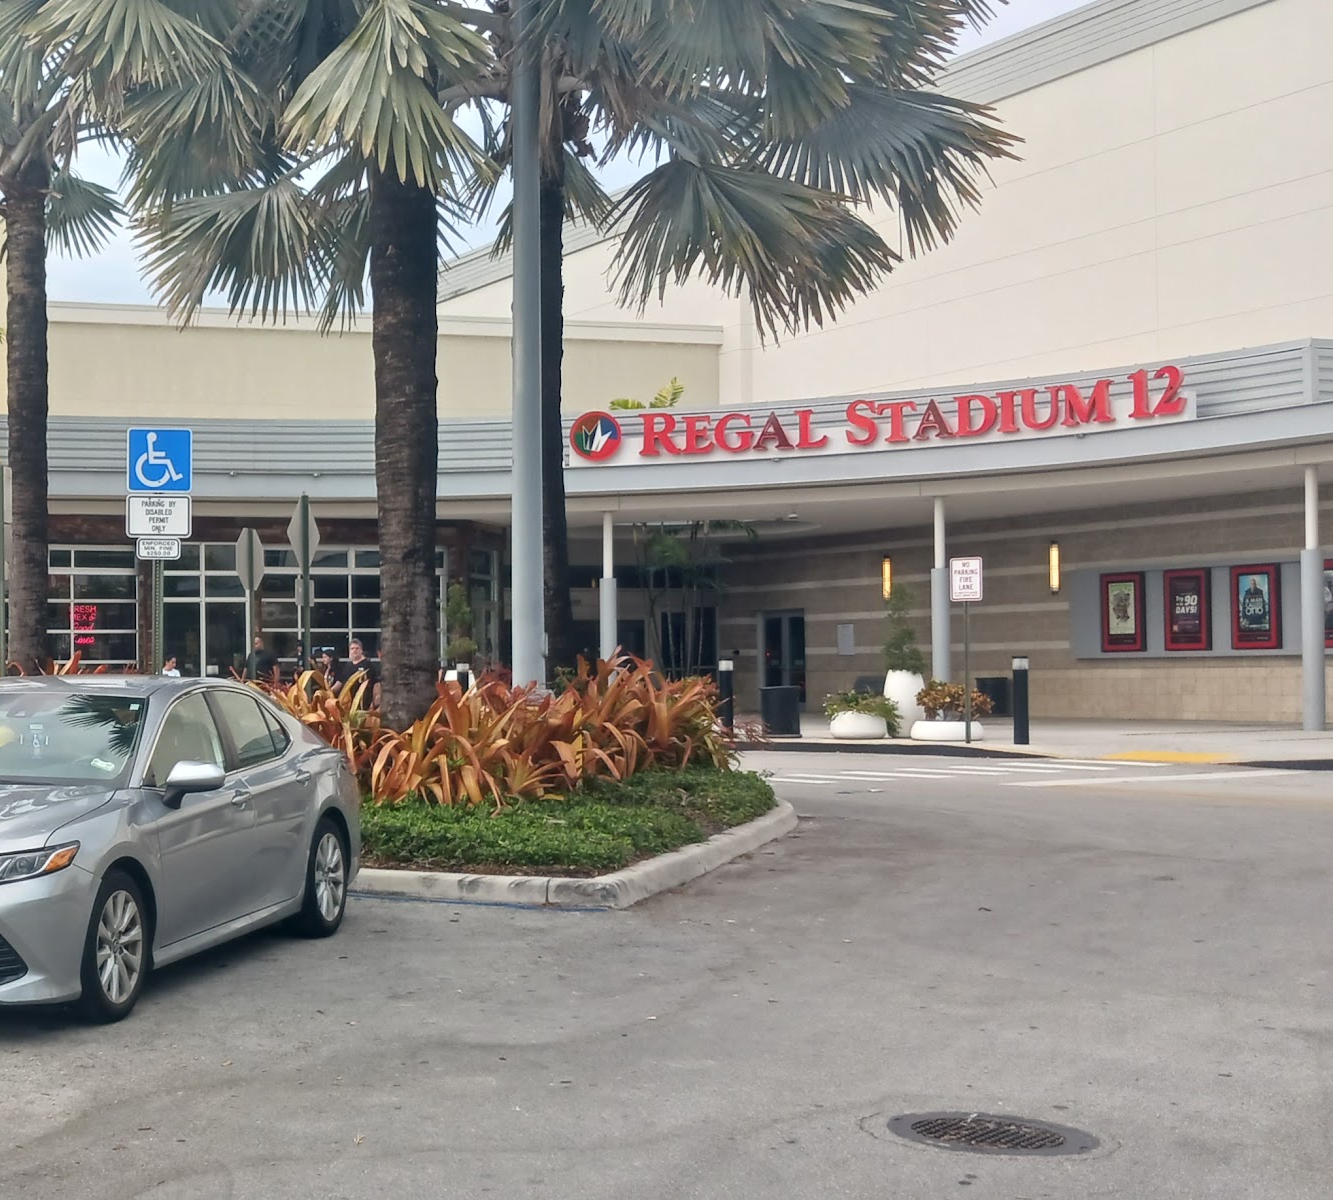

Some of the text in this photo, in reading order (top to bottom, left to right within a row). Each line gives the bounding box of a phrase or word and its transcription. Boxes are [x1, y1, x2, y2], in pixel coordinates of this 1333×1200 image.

[638, 365, 1187, 456] REGAL STADIUM 12
[145, 508, 172, 516] DISABLED
[1184, 594, 1198, 606] 90
[73, 605, 97, 613] RESH
